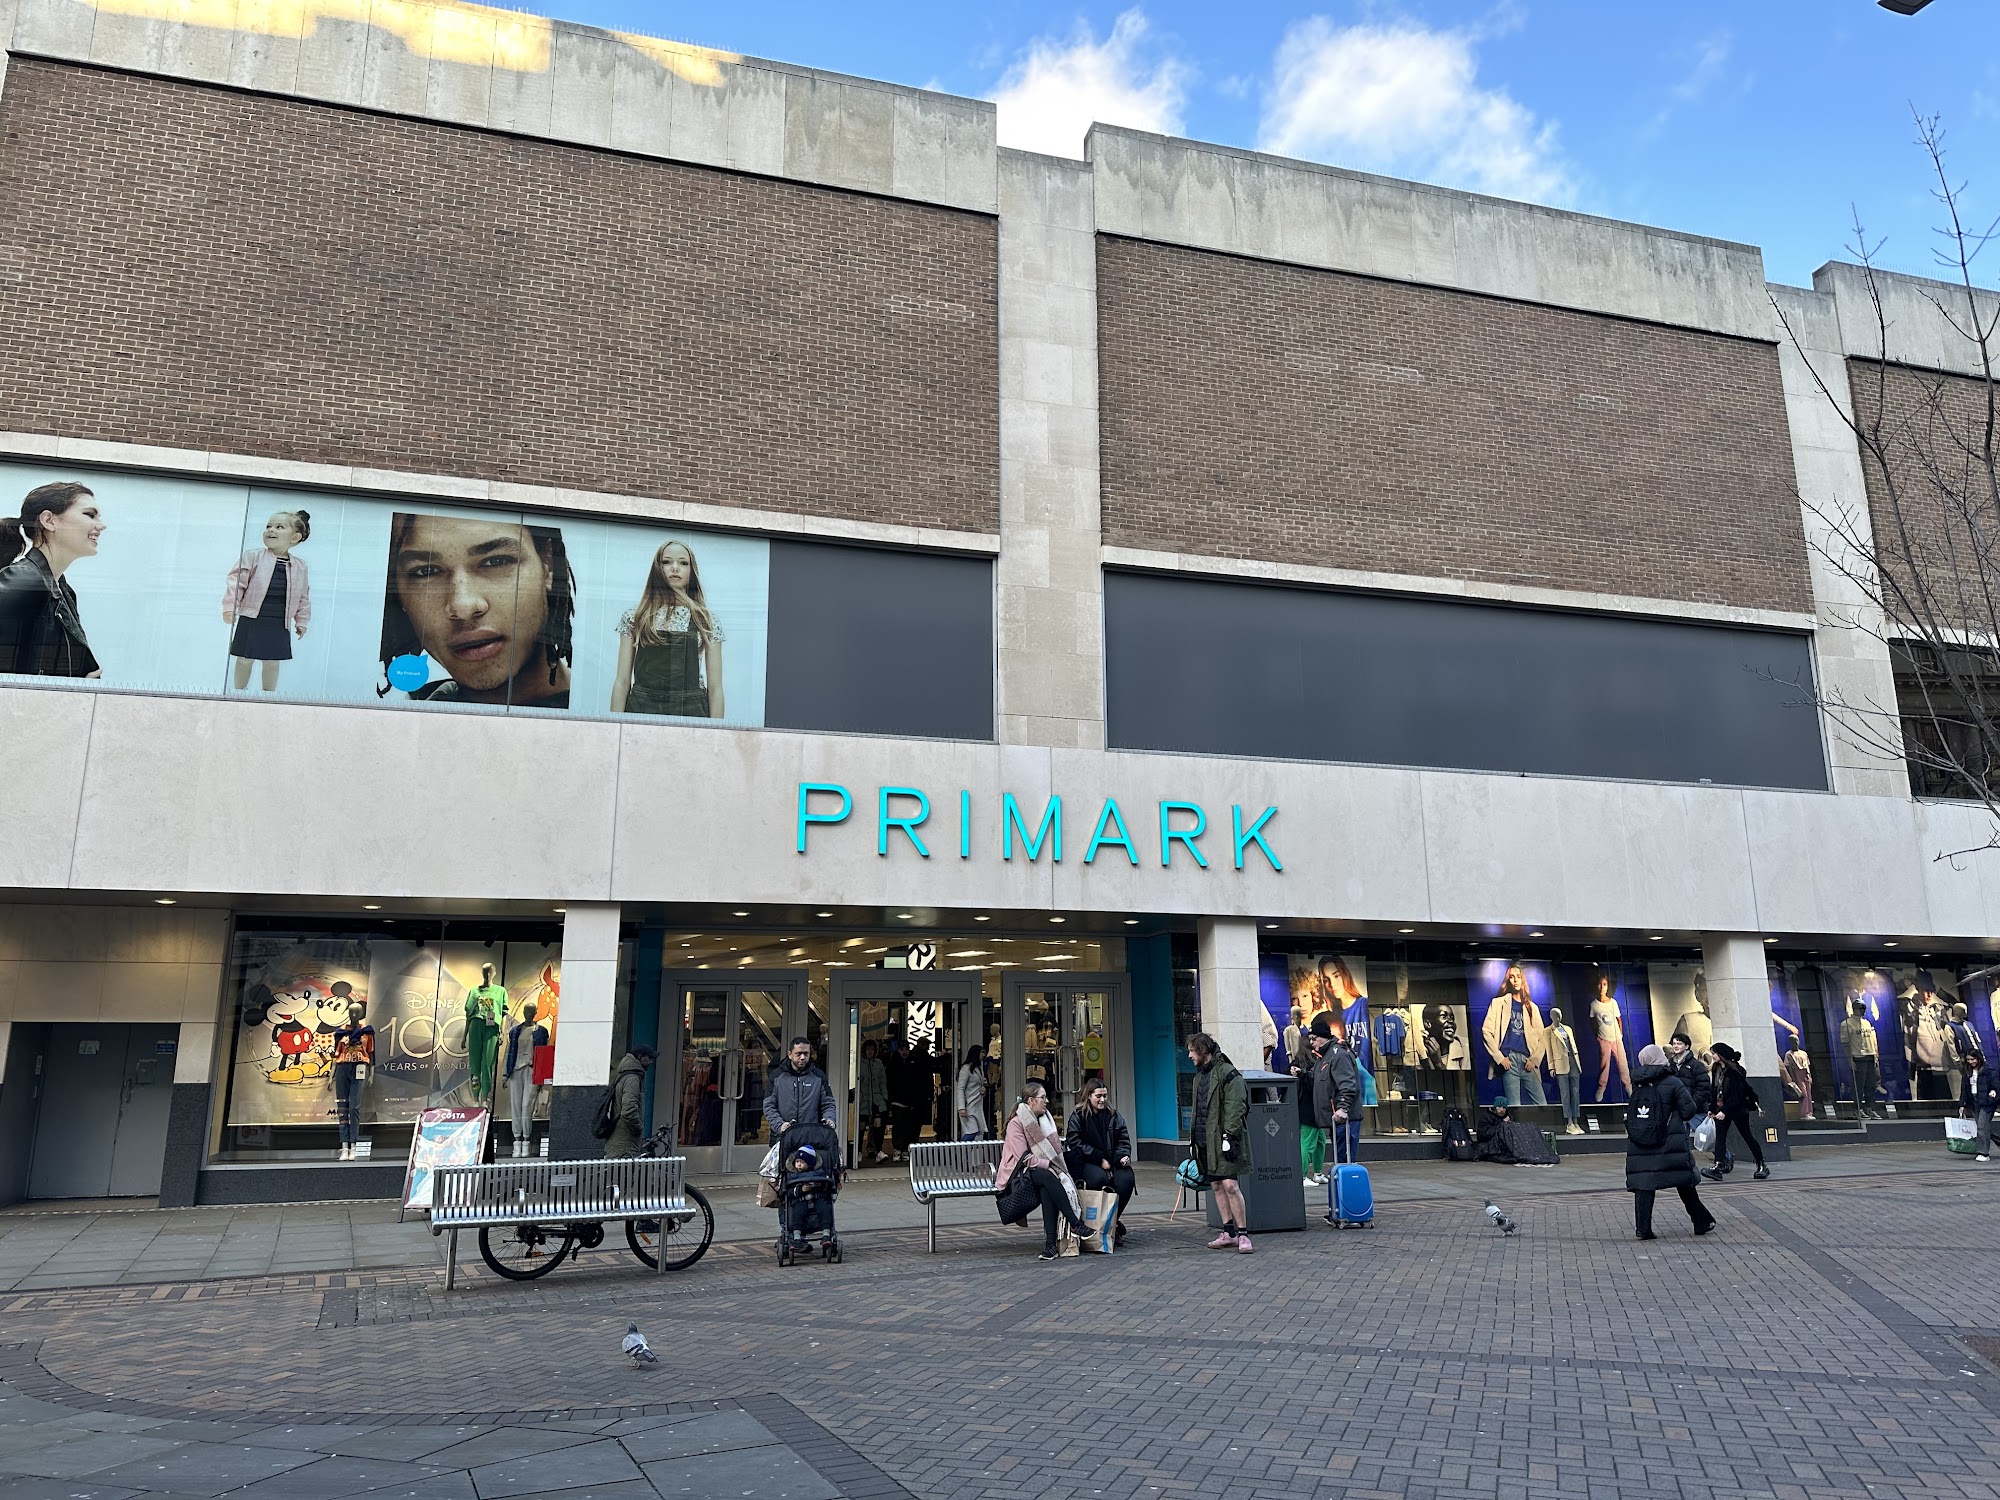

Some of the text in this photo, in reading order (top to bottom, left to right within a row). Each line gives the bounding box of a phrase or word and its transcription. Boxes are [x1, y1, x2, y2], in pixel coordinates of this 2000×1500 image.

[797, 782, 1283, 872] PRIMARK
[403, 990, 462, 1014] Disney
[383, 1062, 417, 1071] YEARS
[433, 1062, 471, 1070] WONDE
[441, 1112, 466, 1120] COSTA
[1258, 1166, 1292, 1174] Nottingham
[1258, 1174, 1269, 1182] City
